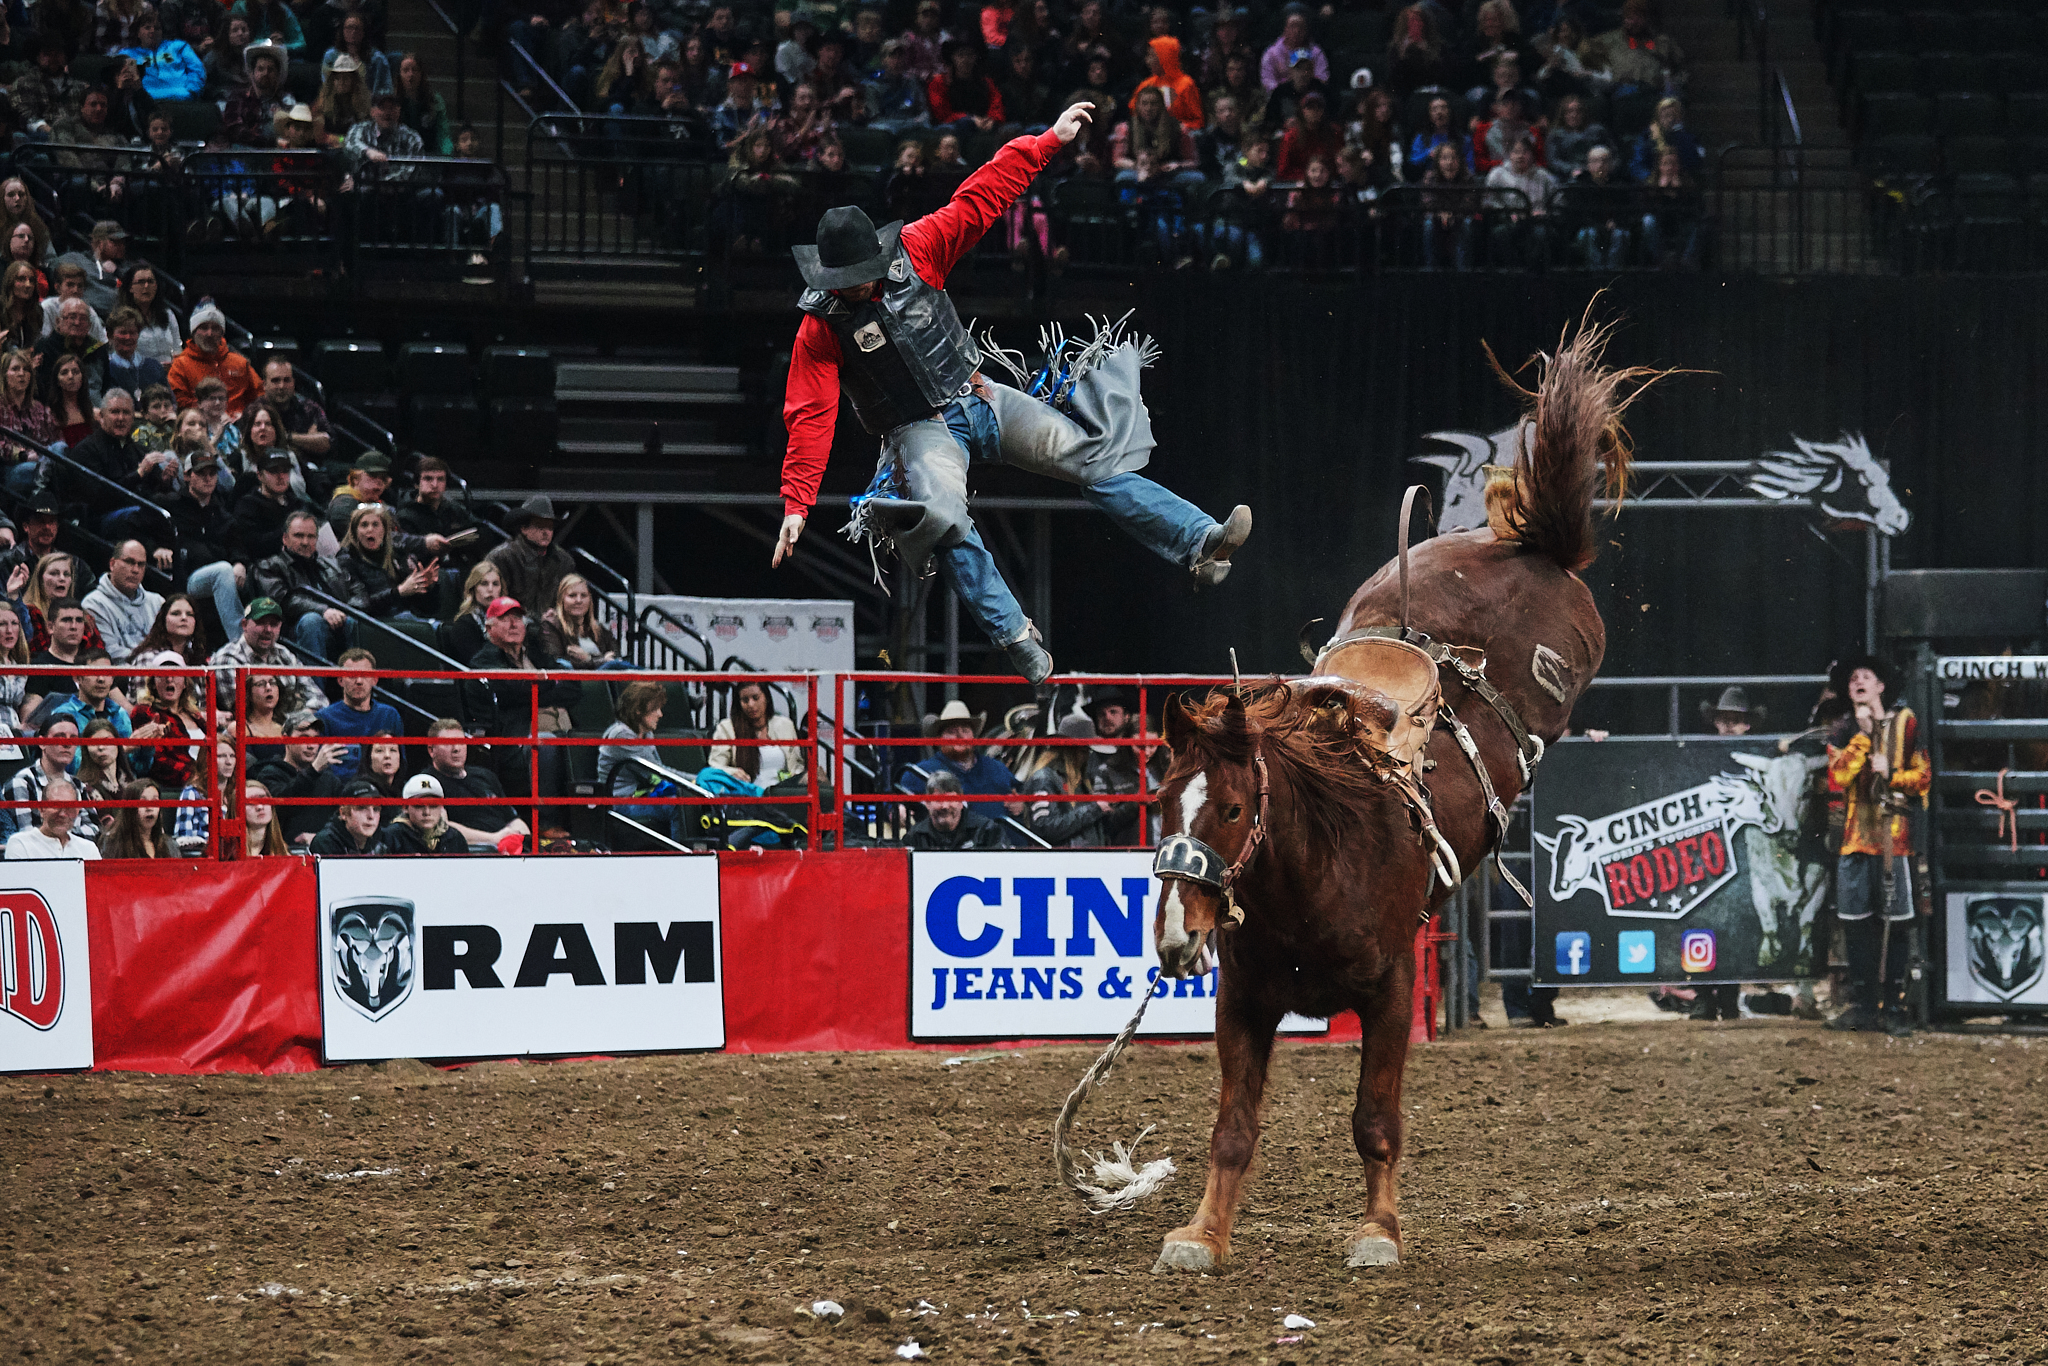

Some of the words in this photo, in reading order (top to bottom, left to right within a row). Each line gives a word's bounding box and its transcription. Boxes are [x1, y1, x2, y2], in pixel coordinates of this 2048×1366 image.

[1943, 660, 2021, 679] CINCH
[1607, 793, 1703, 845] CINCH
[1605, 831, 1725, 908] RODEO
[925, 874, 1163, 960] CIN
[422, 921, 715, 990] RAM
[931, 966, 1084, 1010] JEANS
[1097, 966, 1133, 999] &
